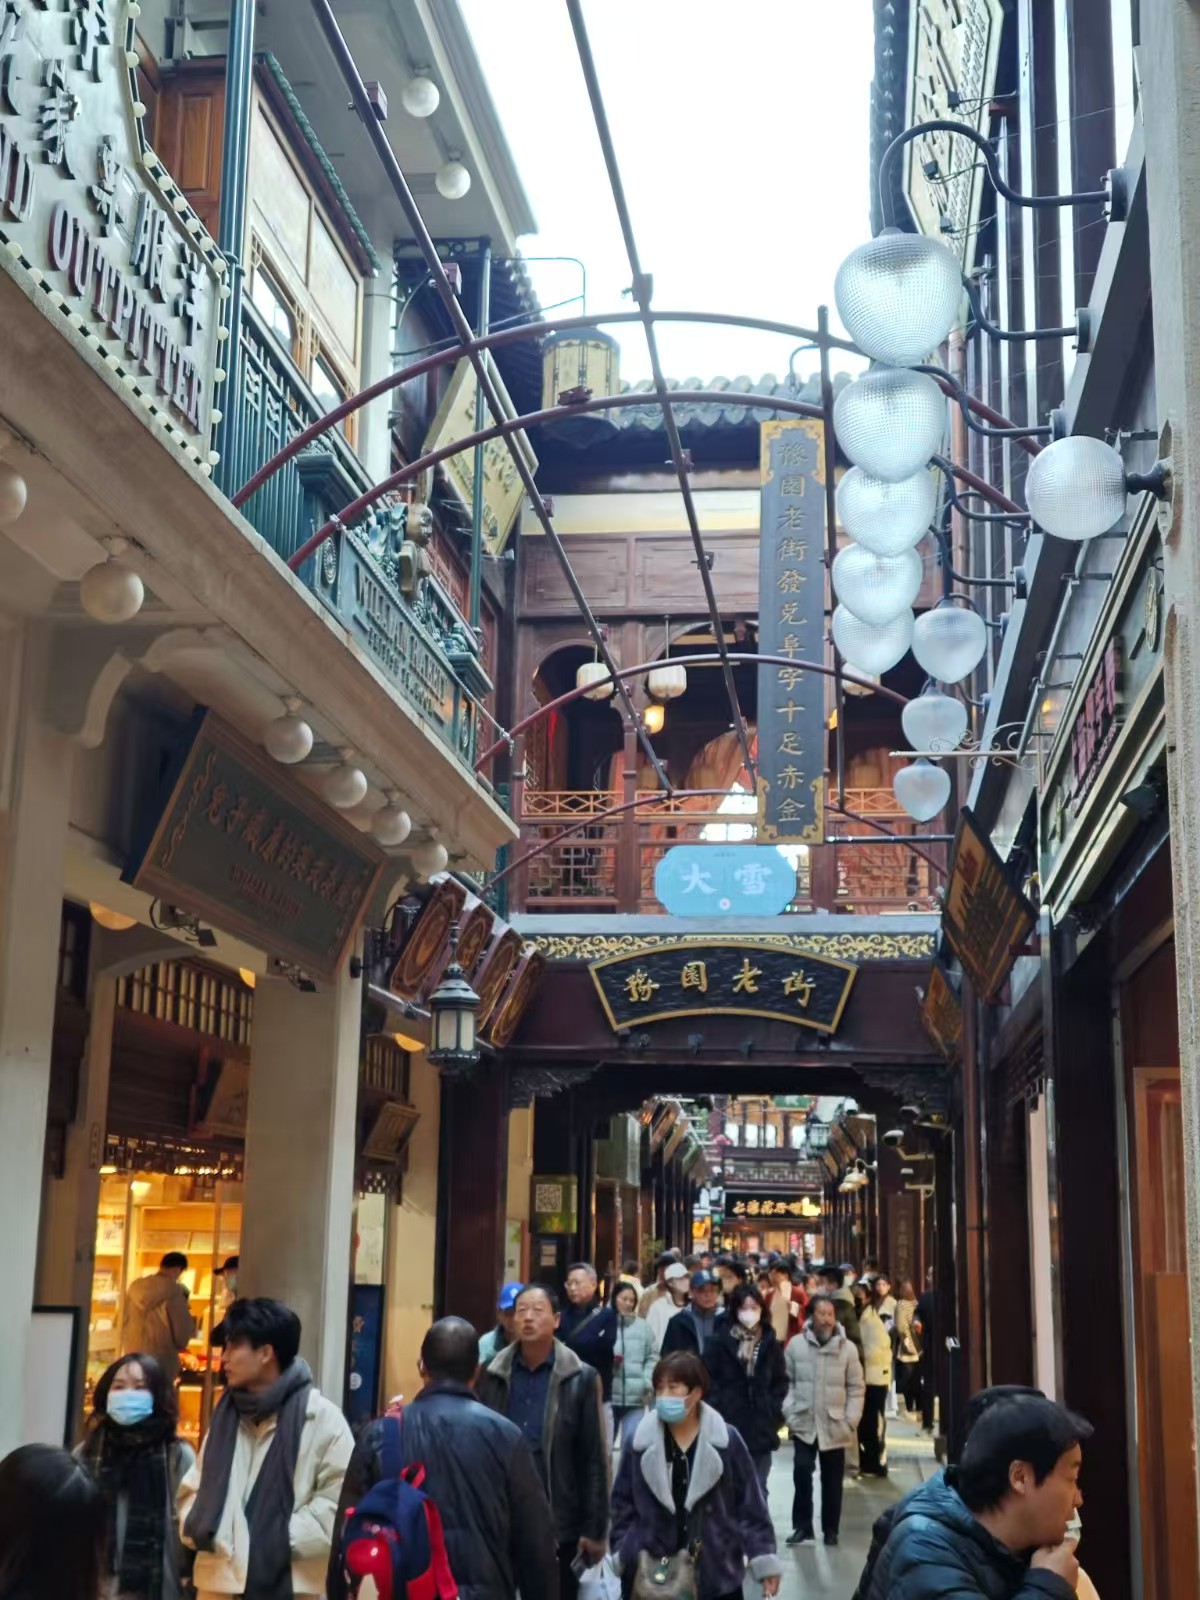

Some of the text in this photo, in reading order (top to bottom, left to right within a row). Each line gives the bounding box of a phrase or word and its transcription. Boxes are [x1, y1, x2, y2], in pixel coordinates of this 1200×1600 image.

[681, 863, 773, 896] 大雪
[623, 958, 817, 1008] 豫園老街
